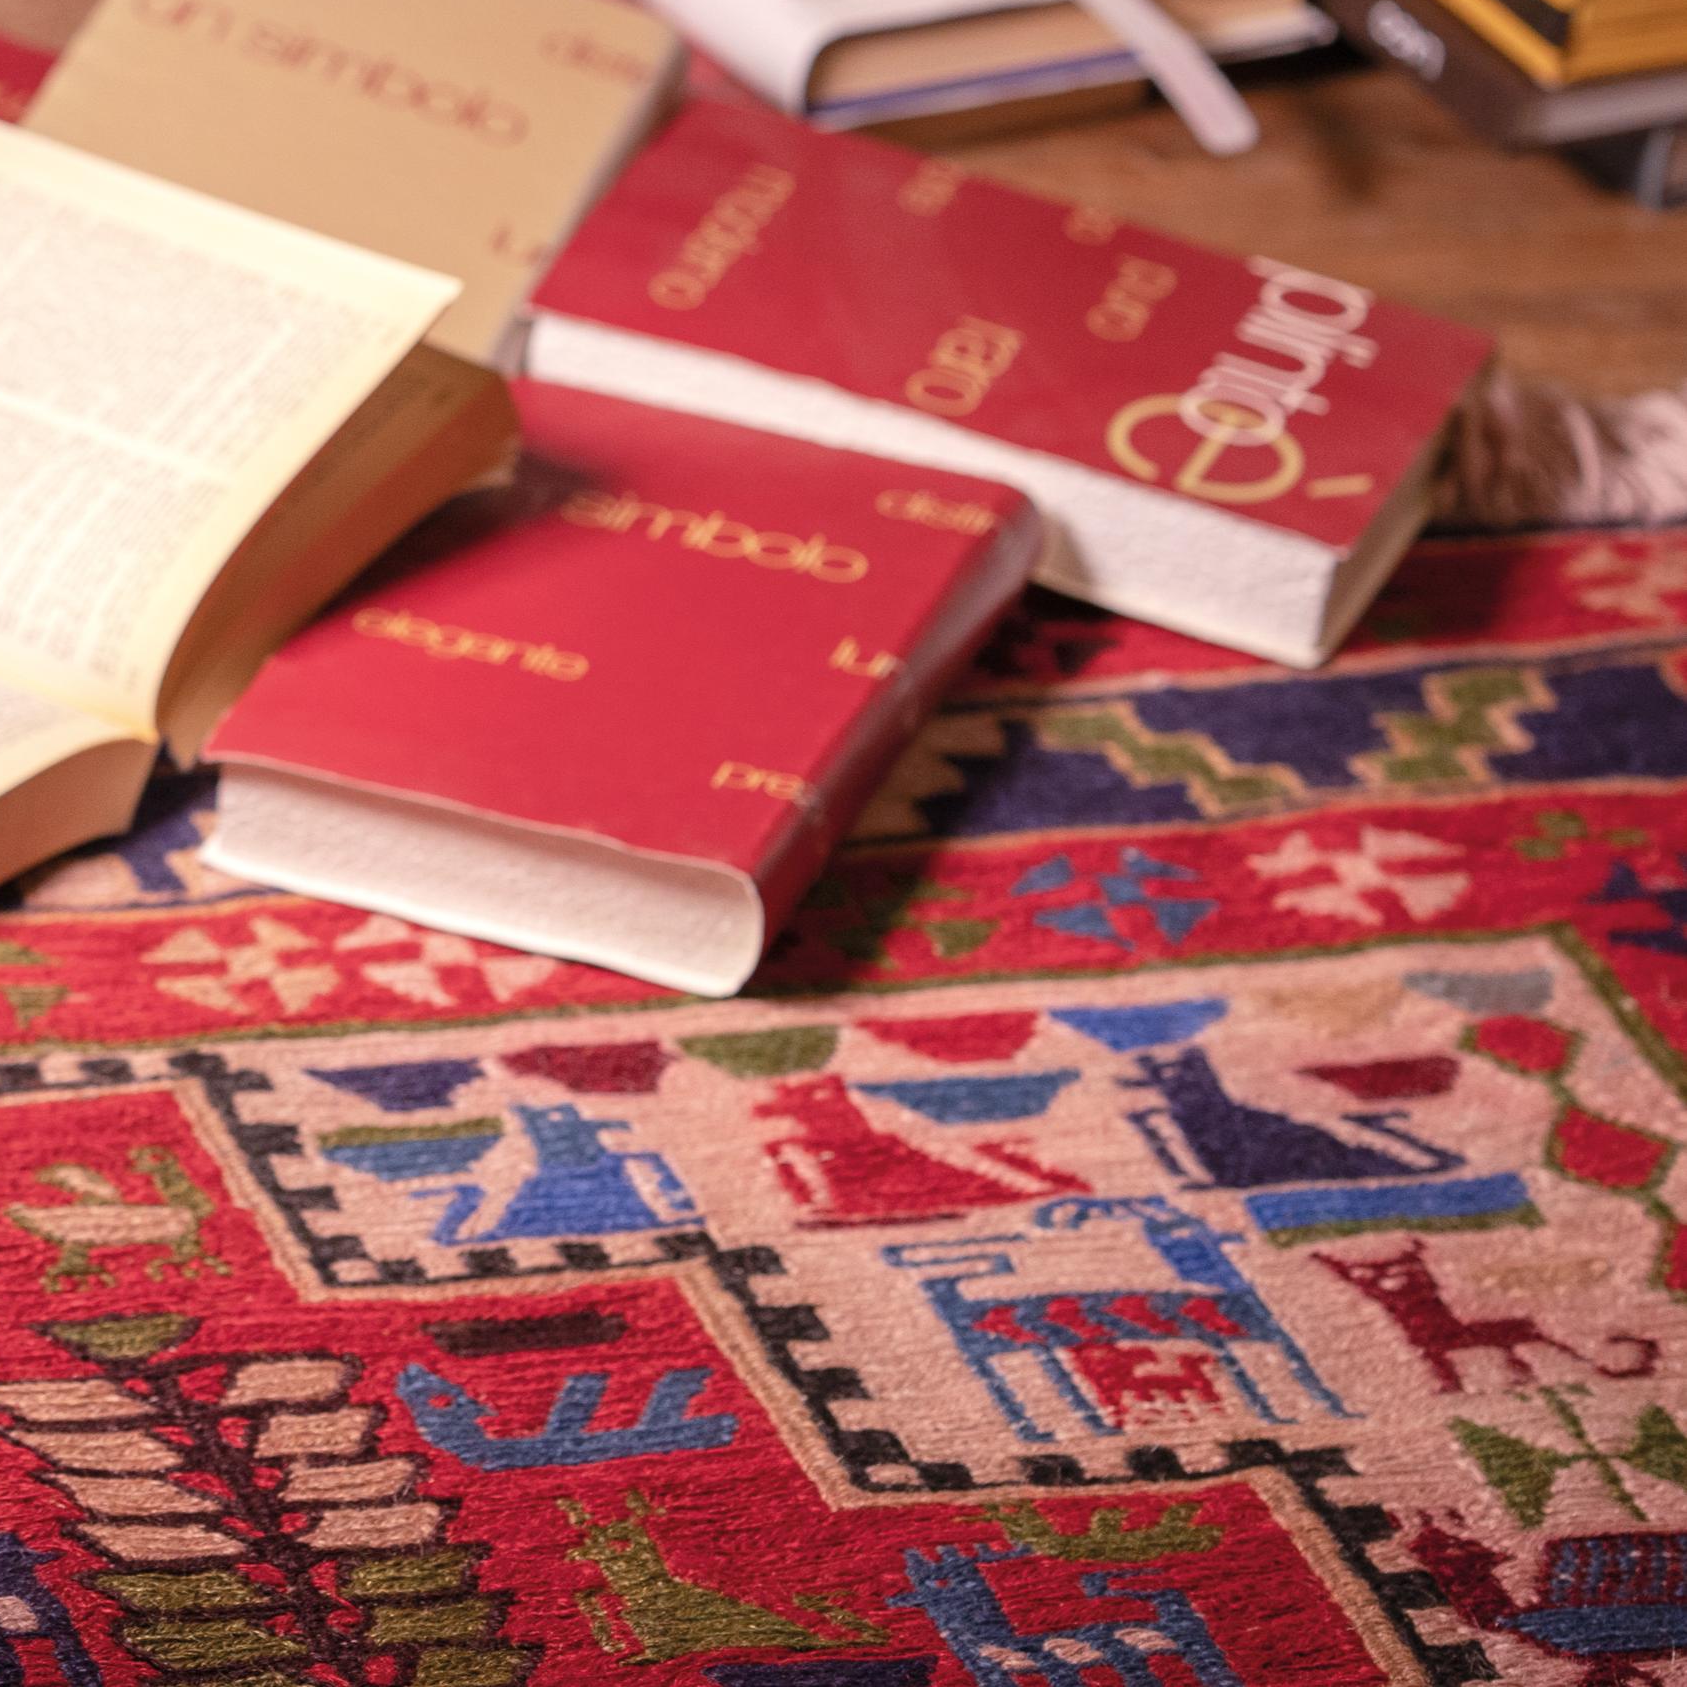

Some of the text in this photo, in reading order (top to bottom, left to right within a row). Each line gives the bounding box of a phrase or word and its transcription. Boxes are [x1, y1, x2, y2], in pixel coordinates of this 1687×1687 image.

[239, 17, 529, 151] simbolo
[902, 314, 1025, 418] raro
[1177, 252, 1381, 448] plinto
[562, 487, 869, 584] simbolo
[350, 605, 591, 683] elegante
